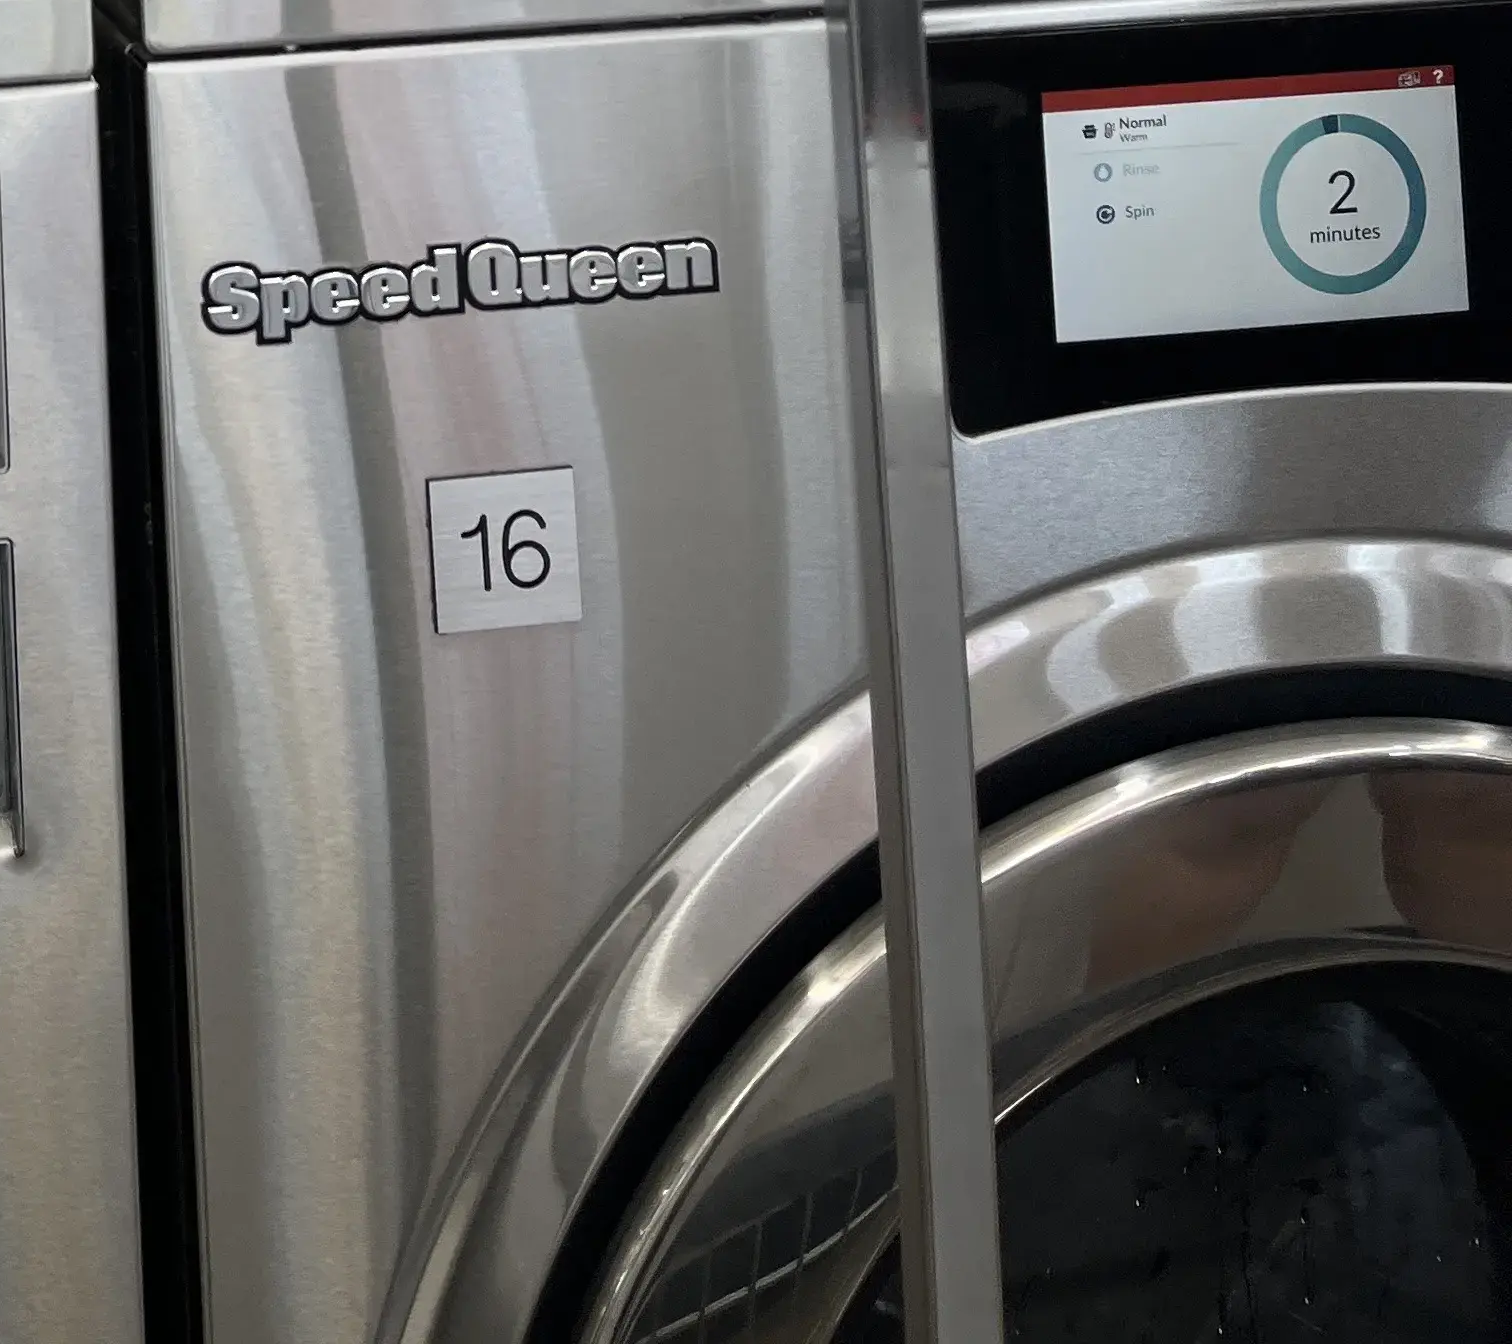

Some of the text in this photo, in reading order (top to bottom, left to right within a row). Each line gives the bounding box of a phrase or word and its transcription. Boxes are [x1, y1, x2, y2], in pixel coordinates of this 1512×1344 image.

[1118, 114, 1167, 131] Normal
[1119, 131, 1148, 143] Warm
[1122, 162, 1160, 177] Rinse
[1328, 170, 1358, 215] 2
[1124, 203, 1156, 221] Spin
[1309, 224, 1381, 244] minutes
[201, 237, 720, 345] Speed Queen
[460, 508, 551, 592] 16
